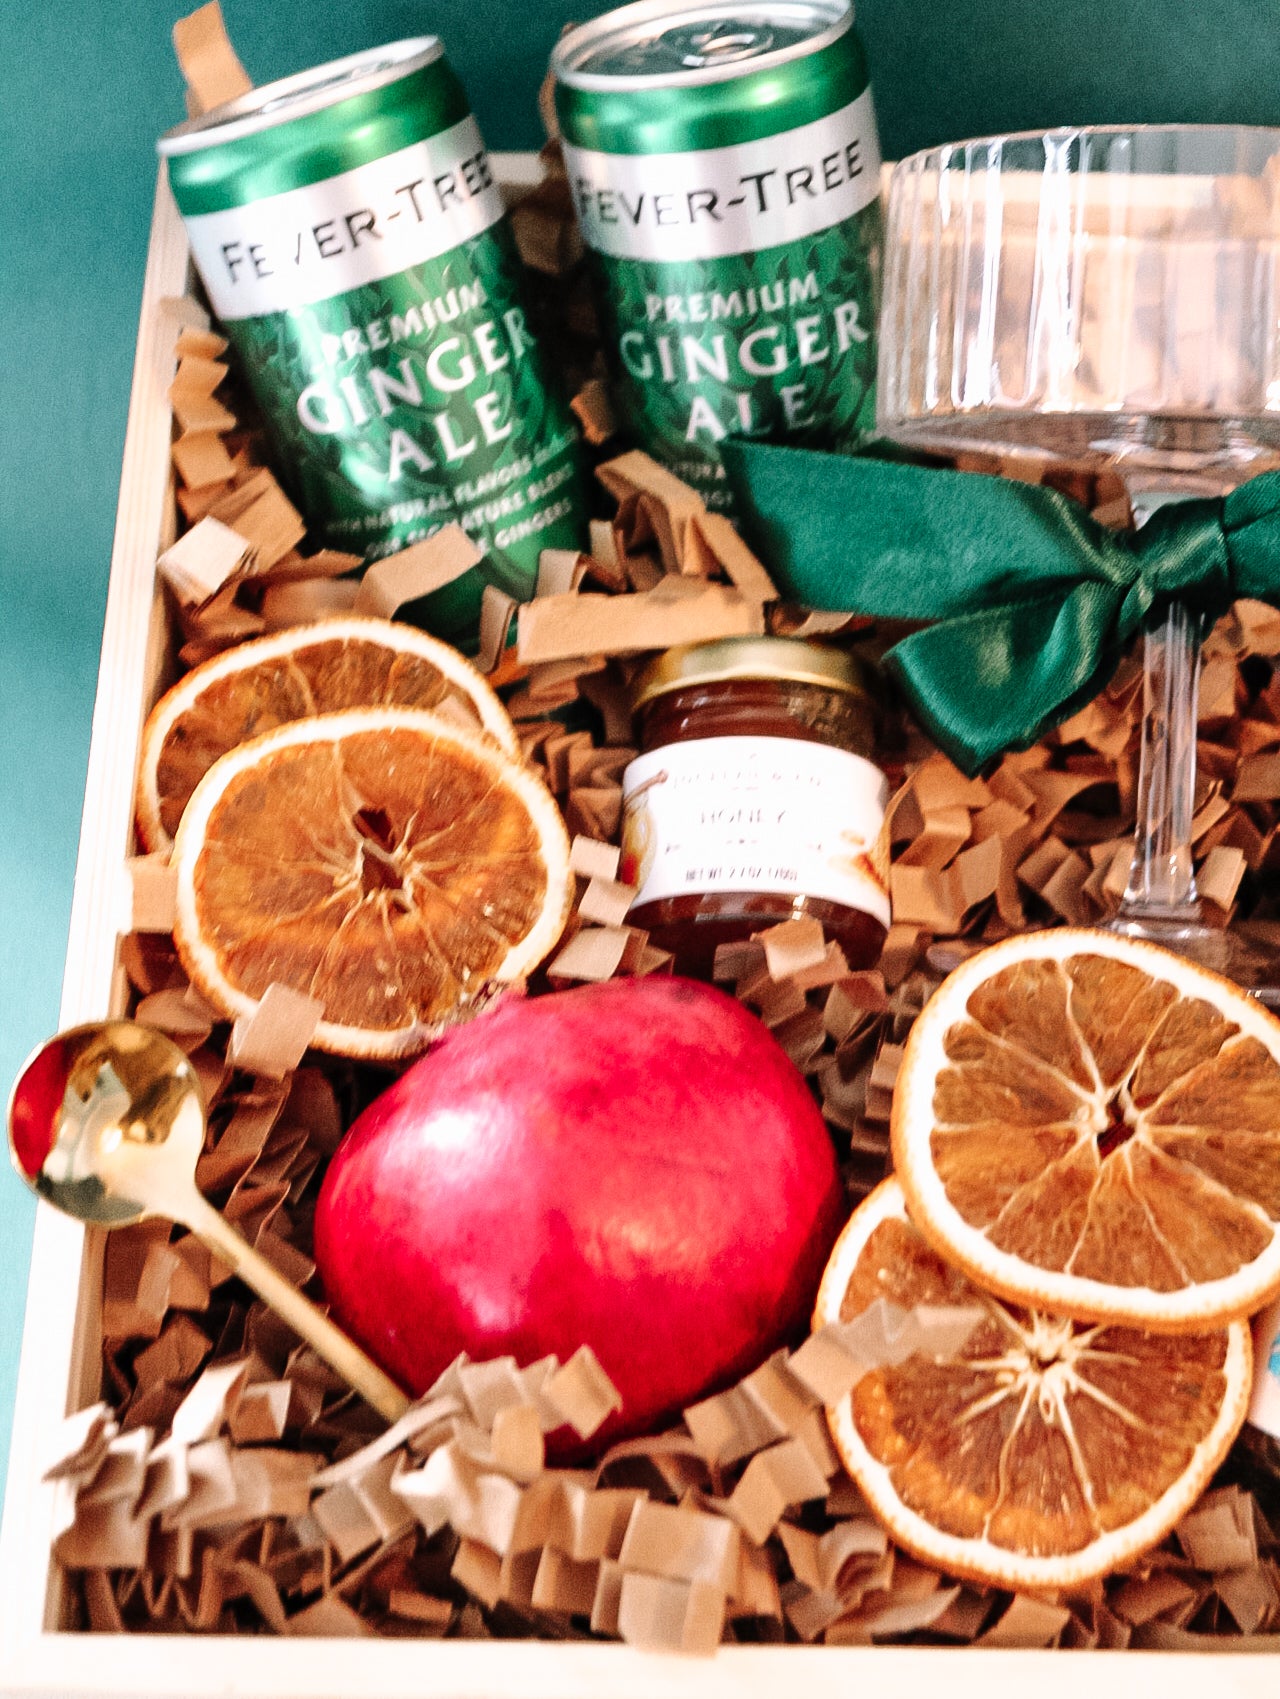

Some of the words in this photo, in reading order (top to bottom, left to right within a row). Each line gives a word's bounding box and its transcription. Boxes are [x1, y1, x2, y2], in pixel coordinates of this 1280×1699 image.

[575, 139, 865, 226] FEVER-TREE
[321, 277, 488, 363] PREMIUM
[645, 272, 820, 324] PREMIUM
[297, 307, 537, 435] GINGER
[619, 301, 870, 384] GINGER
[388, 390, 513, 484] ALE
[685, 383, 816, 443] ALE
